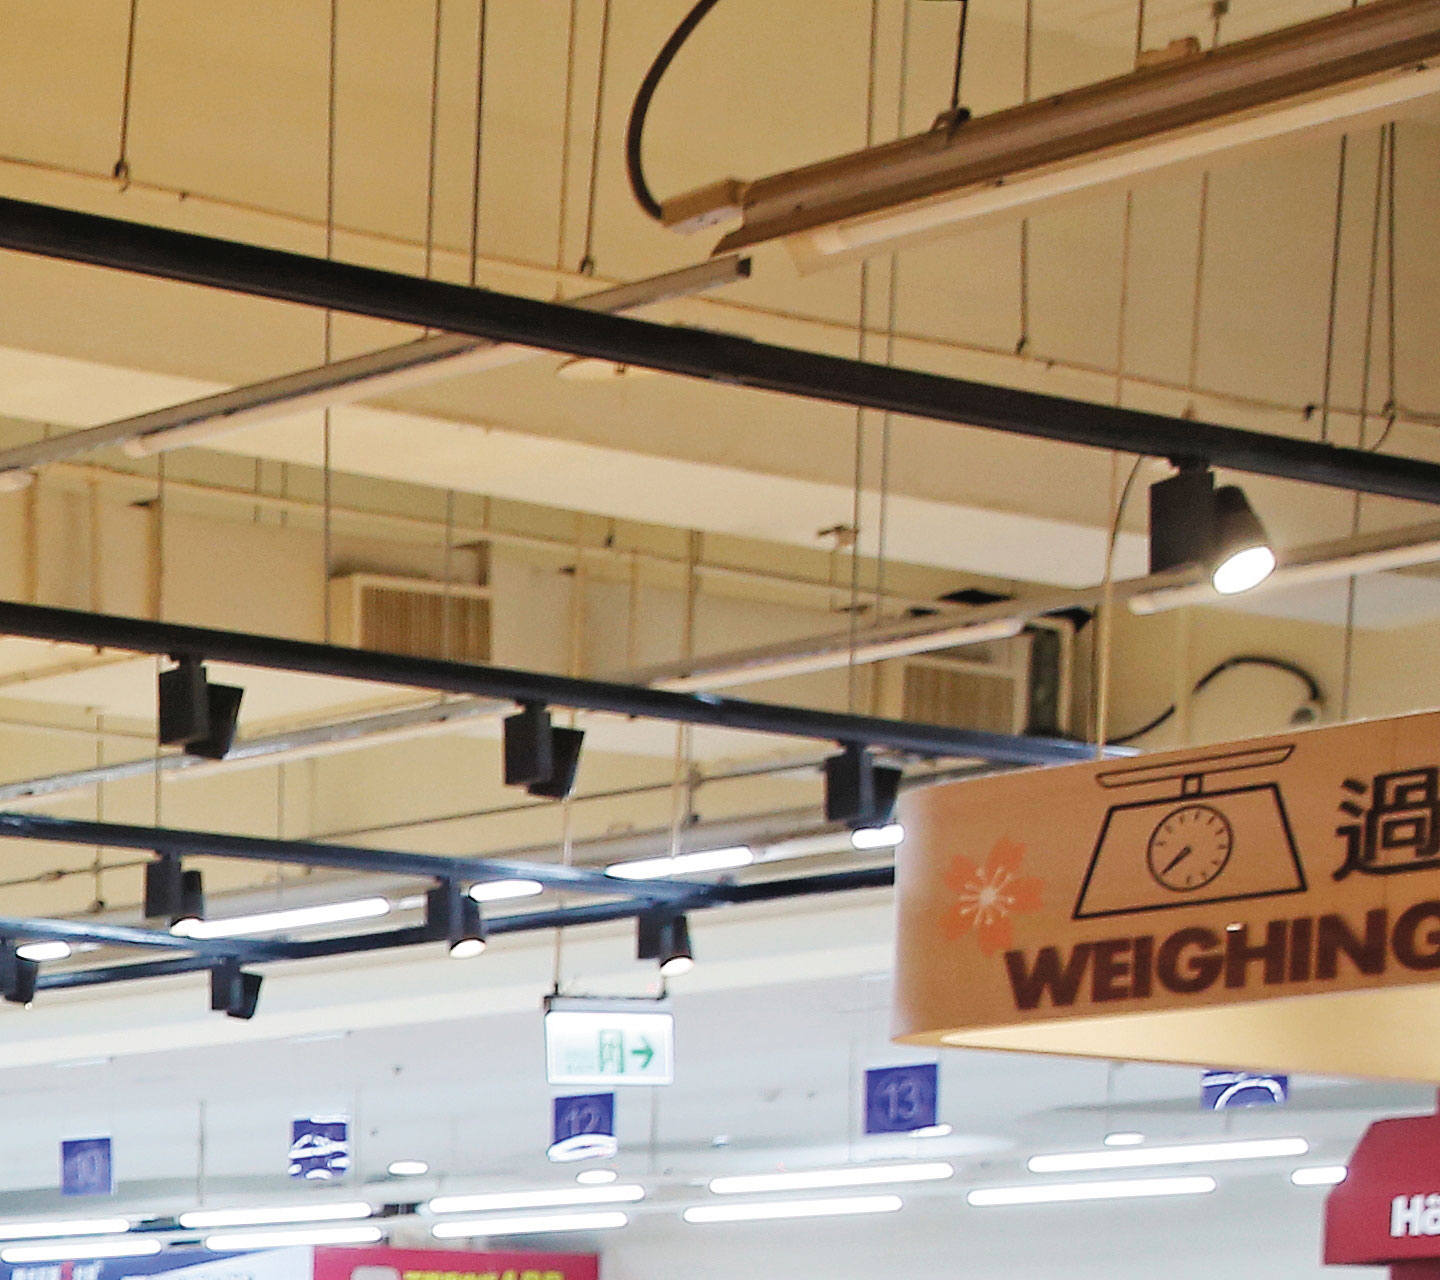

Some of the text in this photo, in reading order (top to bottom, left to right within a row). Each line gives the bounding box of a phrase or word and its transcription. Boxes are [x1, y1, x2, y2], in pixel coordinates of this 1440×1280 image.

[1332, 767, 1440, 880] 過
[1004, 905, 1440, 1010] WEIGHING
[885, 1080, 918, 1121] 13
